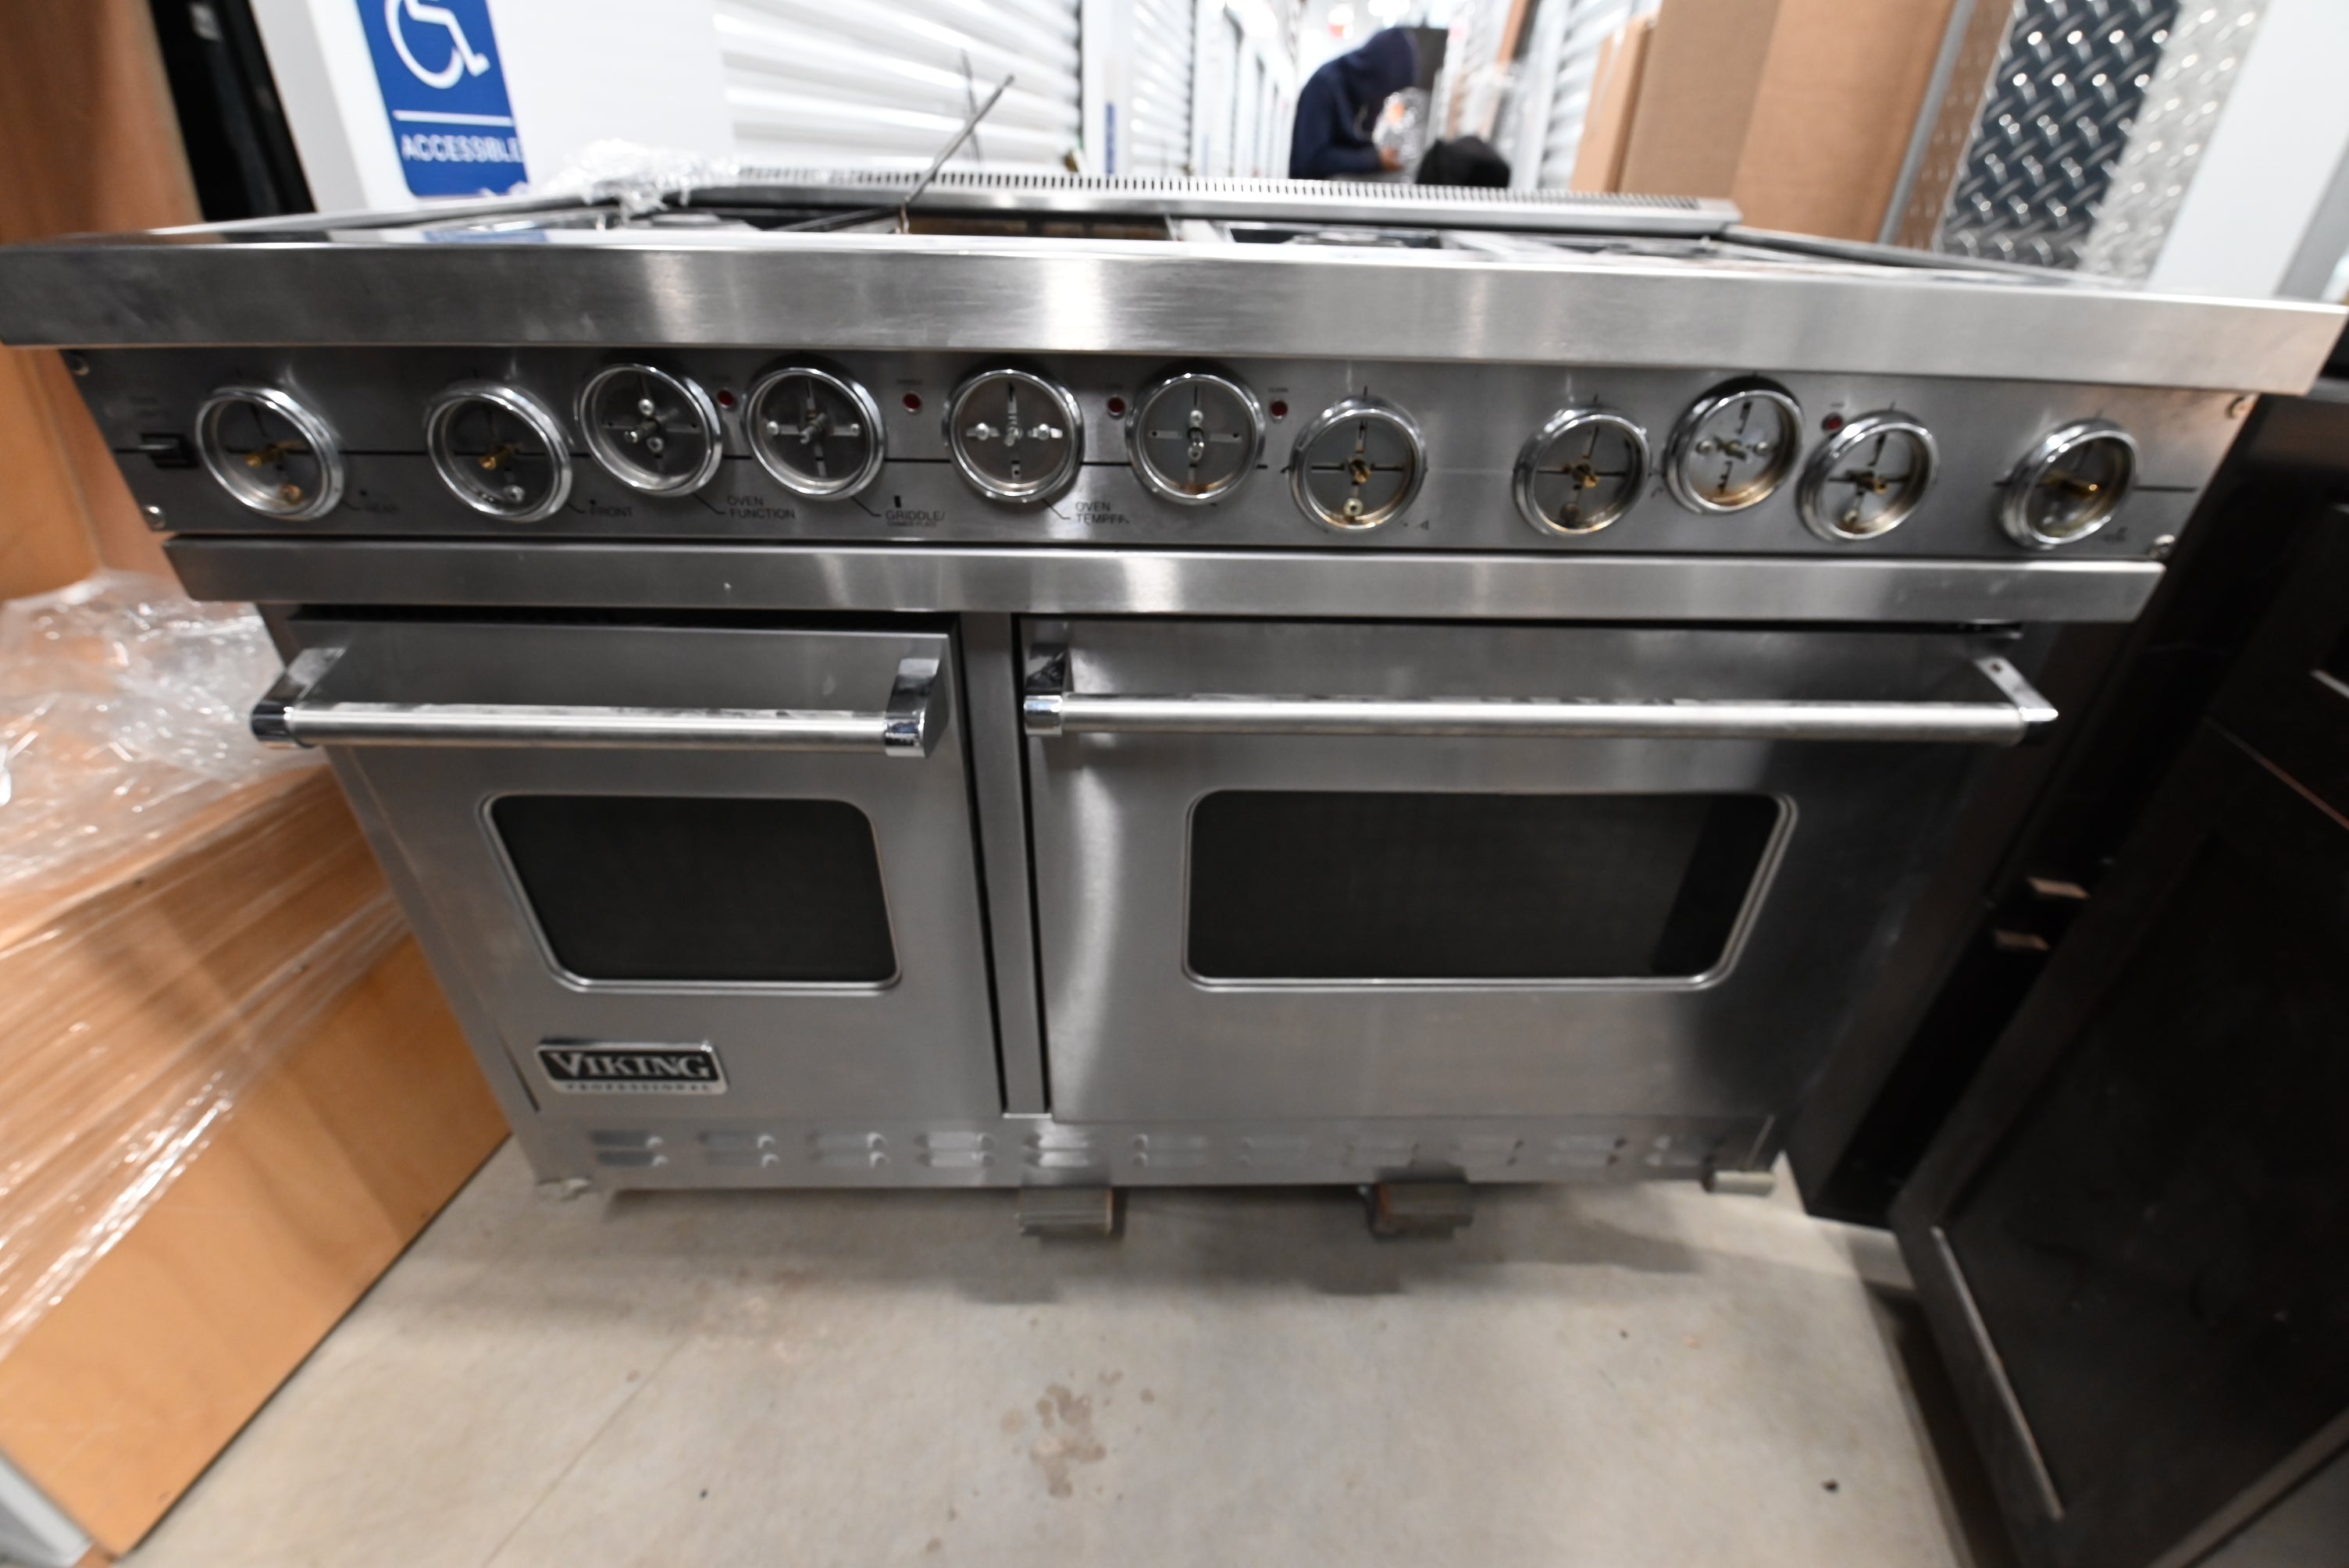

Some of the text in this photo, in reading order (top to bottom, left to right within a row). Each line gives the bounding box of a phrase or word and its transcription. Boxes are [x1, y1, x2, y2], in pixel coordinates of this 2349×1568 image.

[401, 134, 524, 162] ACCESSIBLE
[726, 495, 764, 506] OVEN
[1075, 501, 1110, 512] OVEN
[729, 508, 796, 519] FUNCTION
[549, 1053, 711, 1078] VIKING
